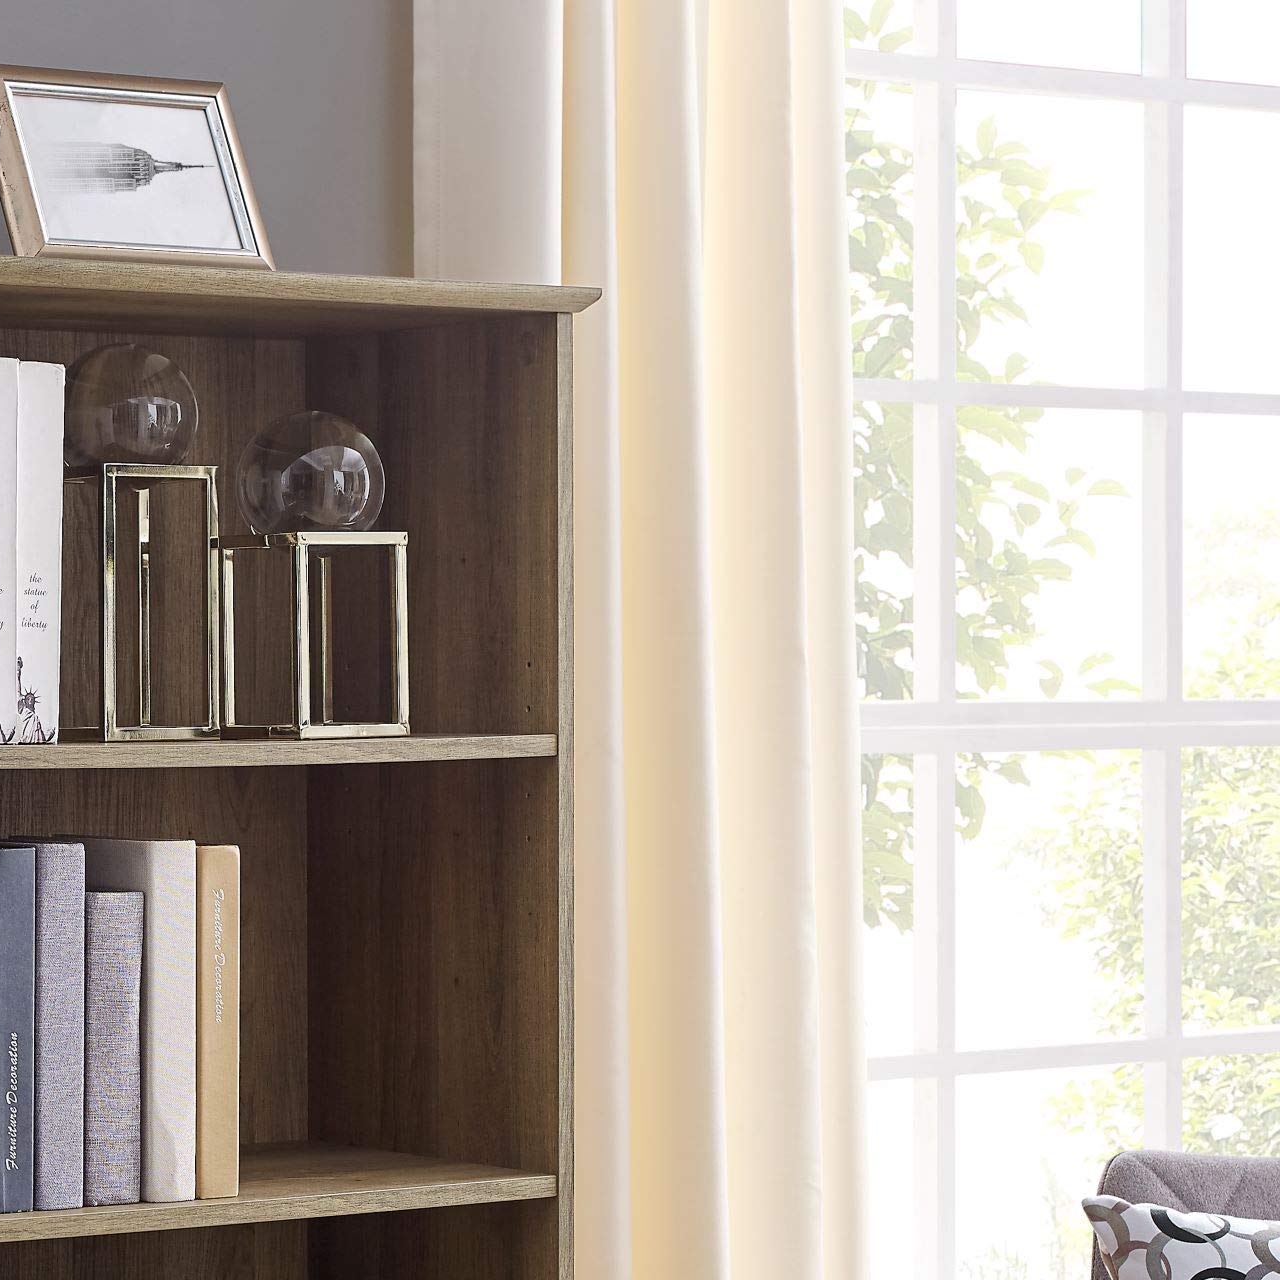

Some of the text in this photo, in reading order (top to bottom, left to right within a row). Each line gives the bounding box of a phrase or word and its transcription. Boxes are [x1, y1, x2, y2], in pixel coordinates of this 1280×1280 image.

[29, 572, 42, 583] the
[23, 588, 48, 596] statue
[30, 599, 40, 614] of
[21, 617, 48, 632] liberty
[212, 888, 226, 1024] Furniture Decoration
[5, 1032, 19, 1171] Furniture Decoration
